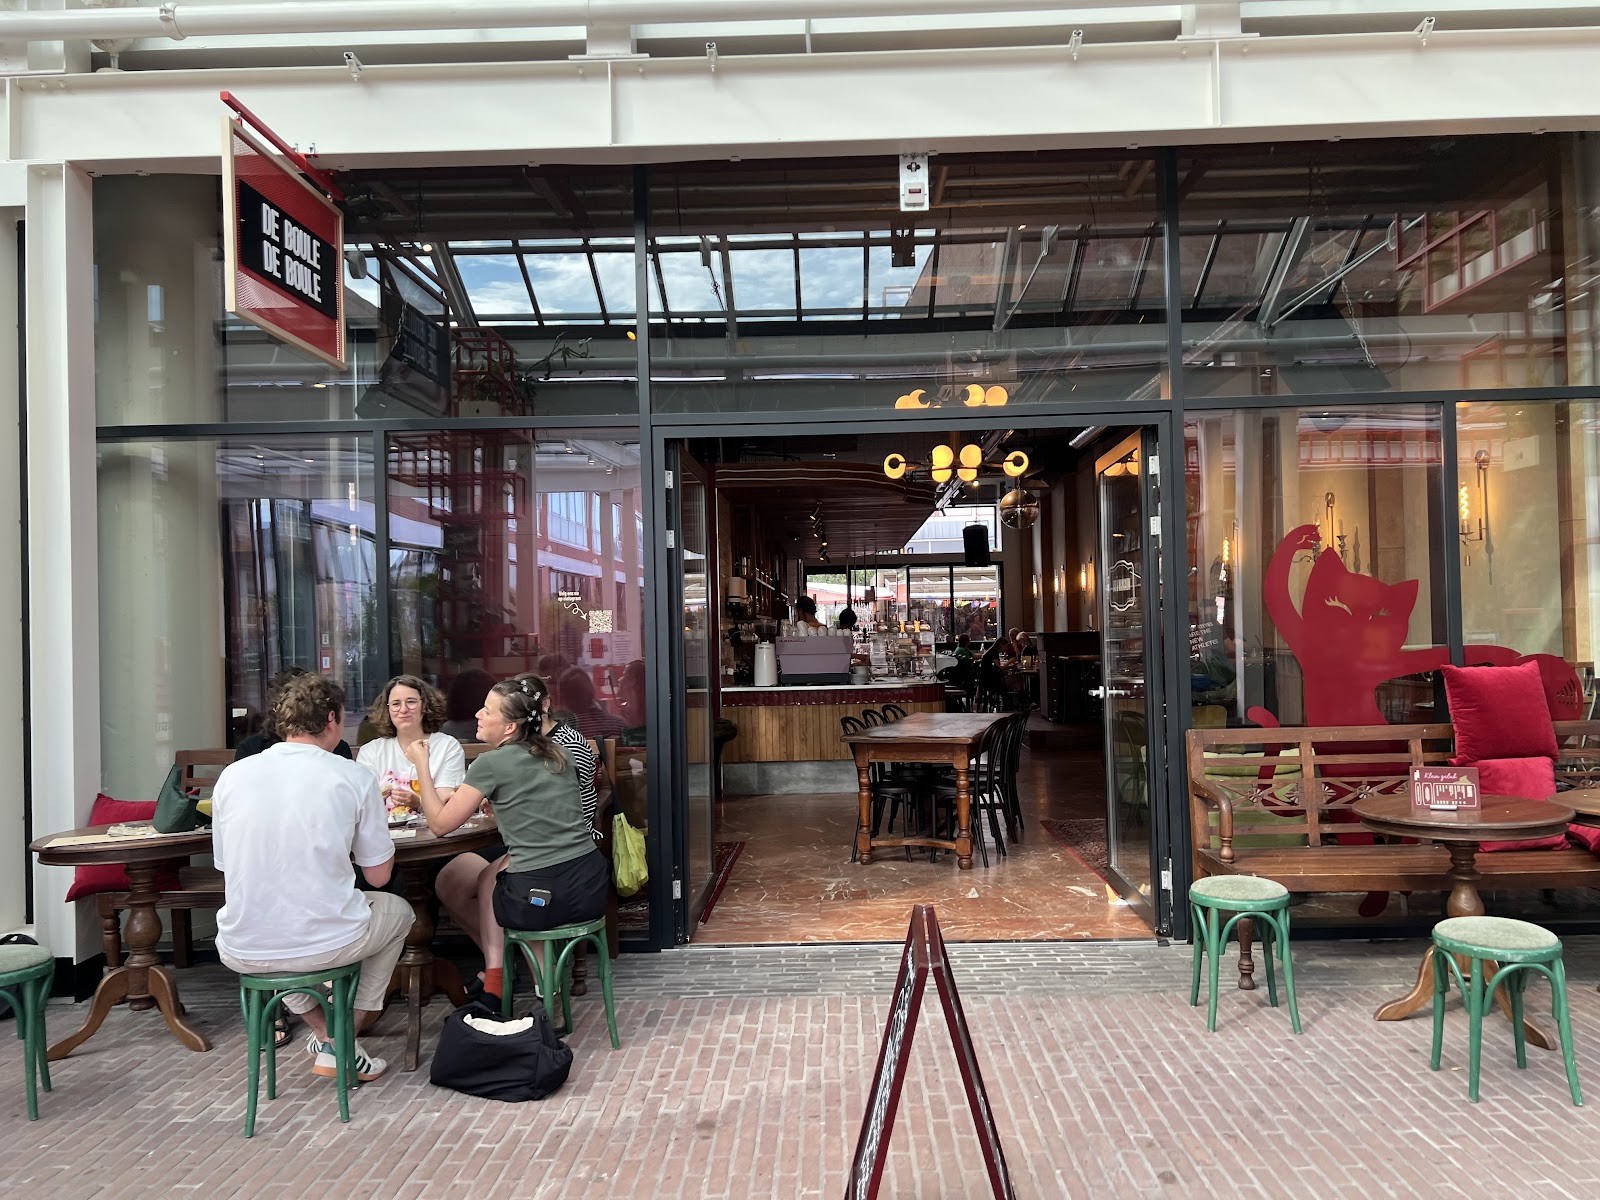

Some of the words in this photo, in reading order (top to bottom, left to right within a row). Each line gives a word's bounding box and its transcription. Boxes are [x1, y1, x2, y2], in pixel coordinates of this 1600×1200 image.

[262, 202, 280, 242] DE
[284, 219, 321, 271] BOULE
[263, 239, 282, 279] DE
[285, 254, 322, 303] BOULE
